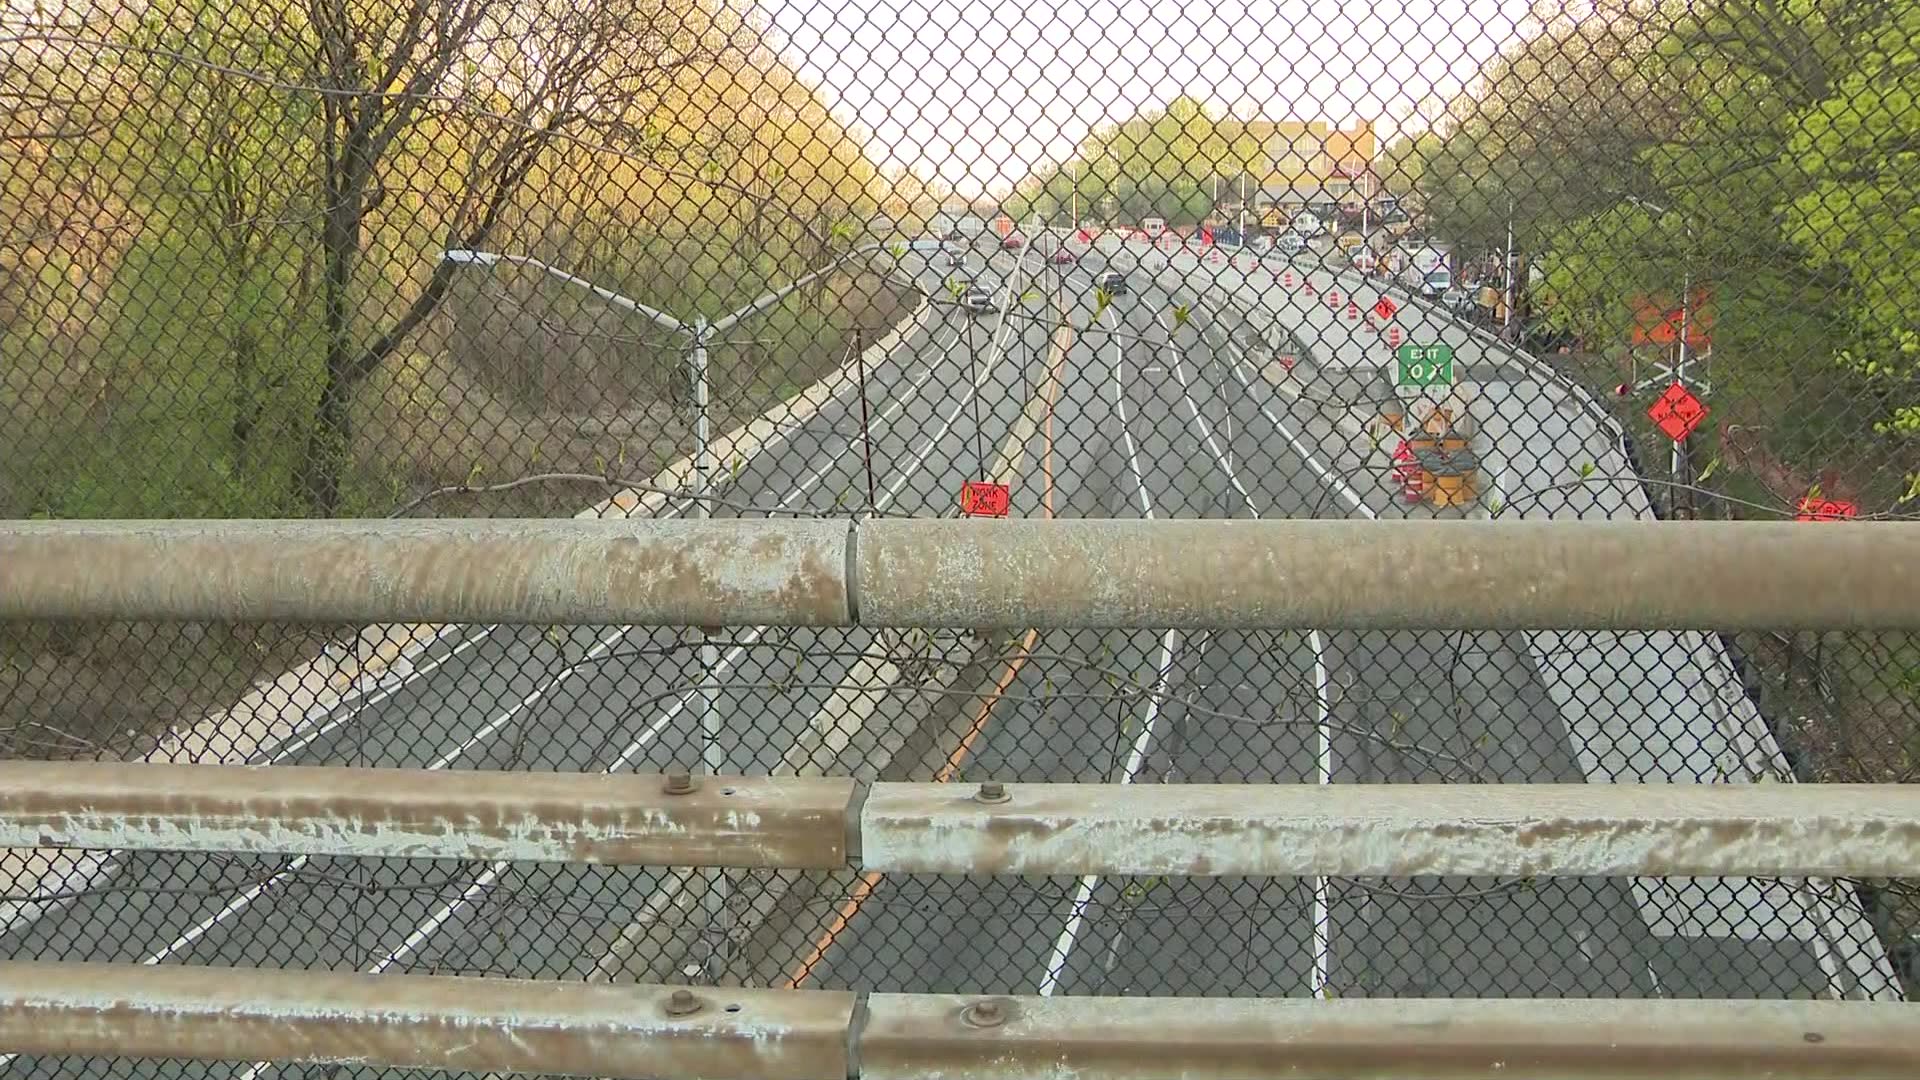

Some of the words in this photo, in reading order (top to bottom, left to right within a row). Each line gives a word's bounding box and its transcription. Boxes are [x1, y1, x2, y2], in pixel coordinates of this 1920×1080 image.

[1410, 348, 1439, 360] EXIT
[972, 486, 999, 498] WORK
[972, 500, 997, 510] ZONE
